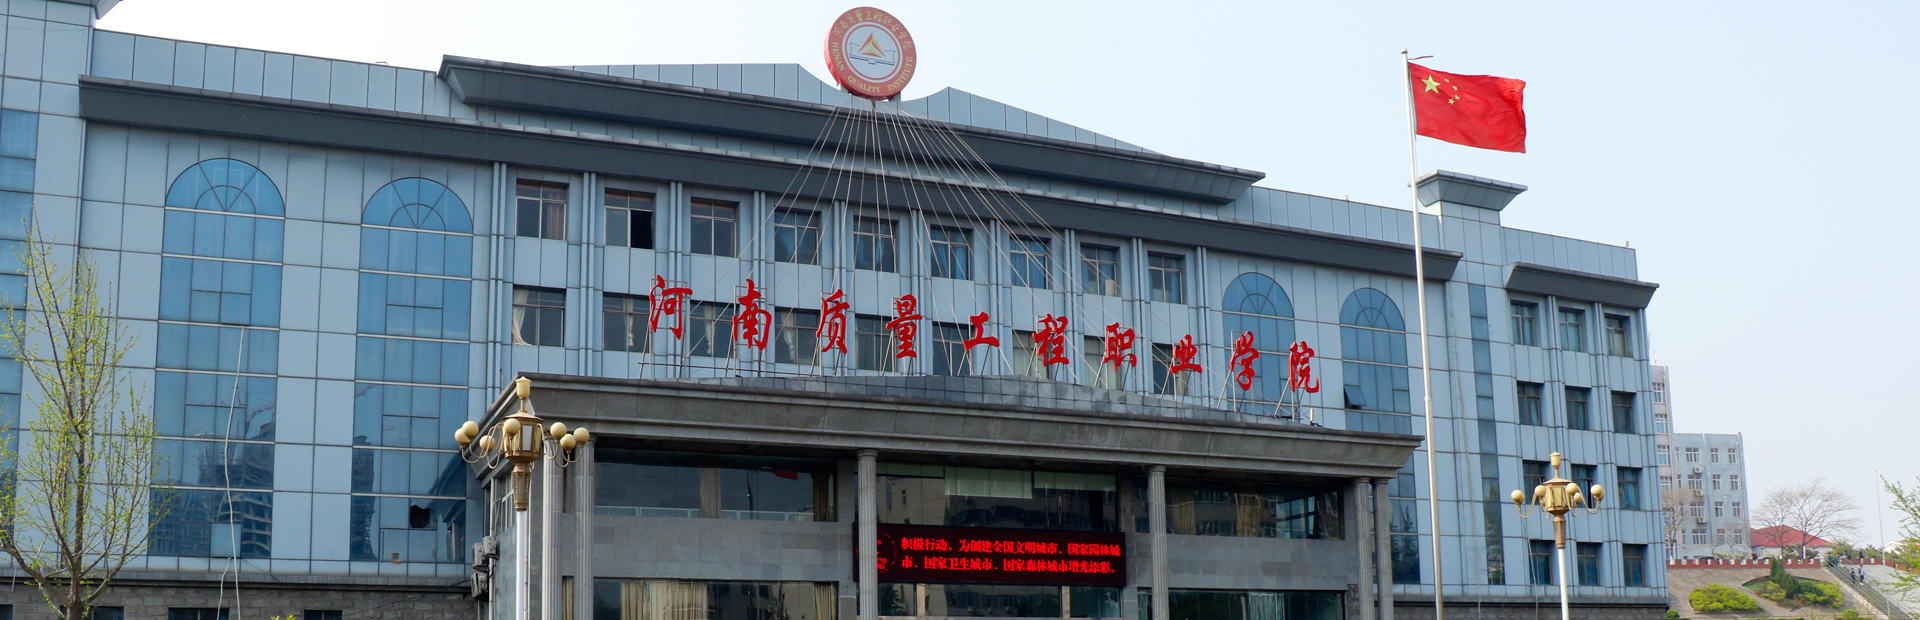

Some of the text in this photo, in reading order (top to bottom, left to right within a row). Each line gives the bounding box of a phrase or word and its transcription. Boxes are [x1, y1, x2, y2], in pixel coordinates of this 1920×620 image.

[833, 9, 913, 50] 河南质量工程职业学院
[832, 42, 913, 93] HENAN QUALITY INSTITUTE
[648, 274, 1321, 394] 河南质量工程职业学院
